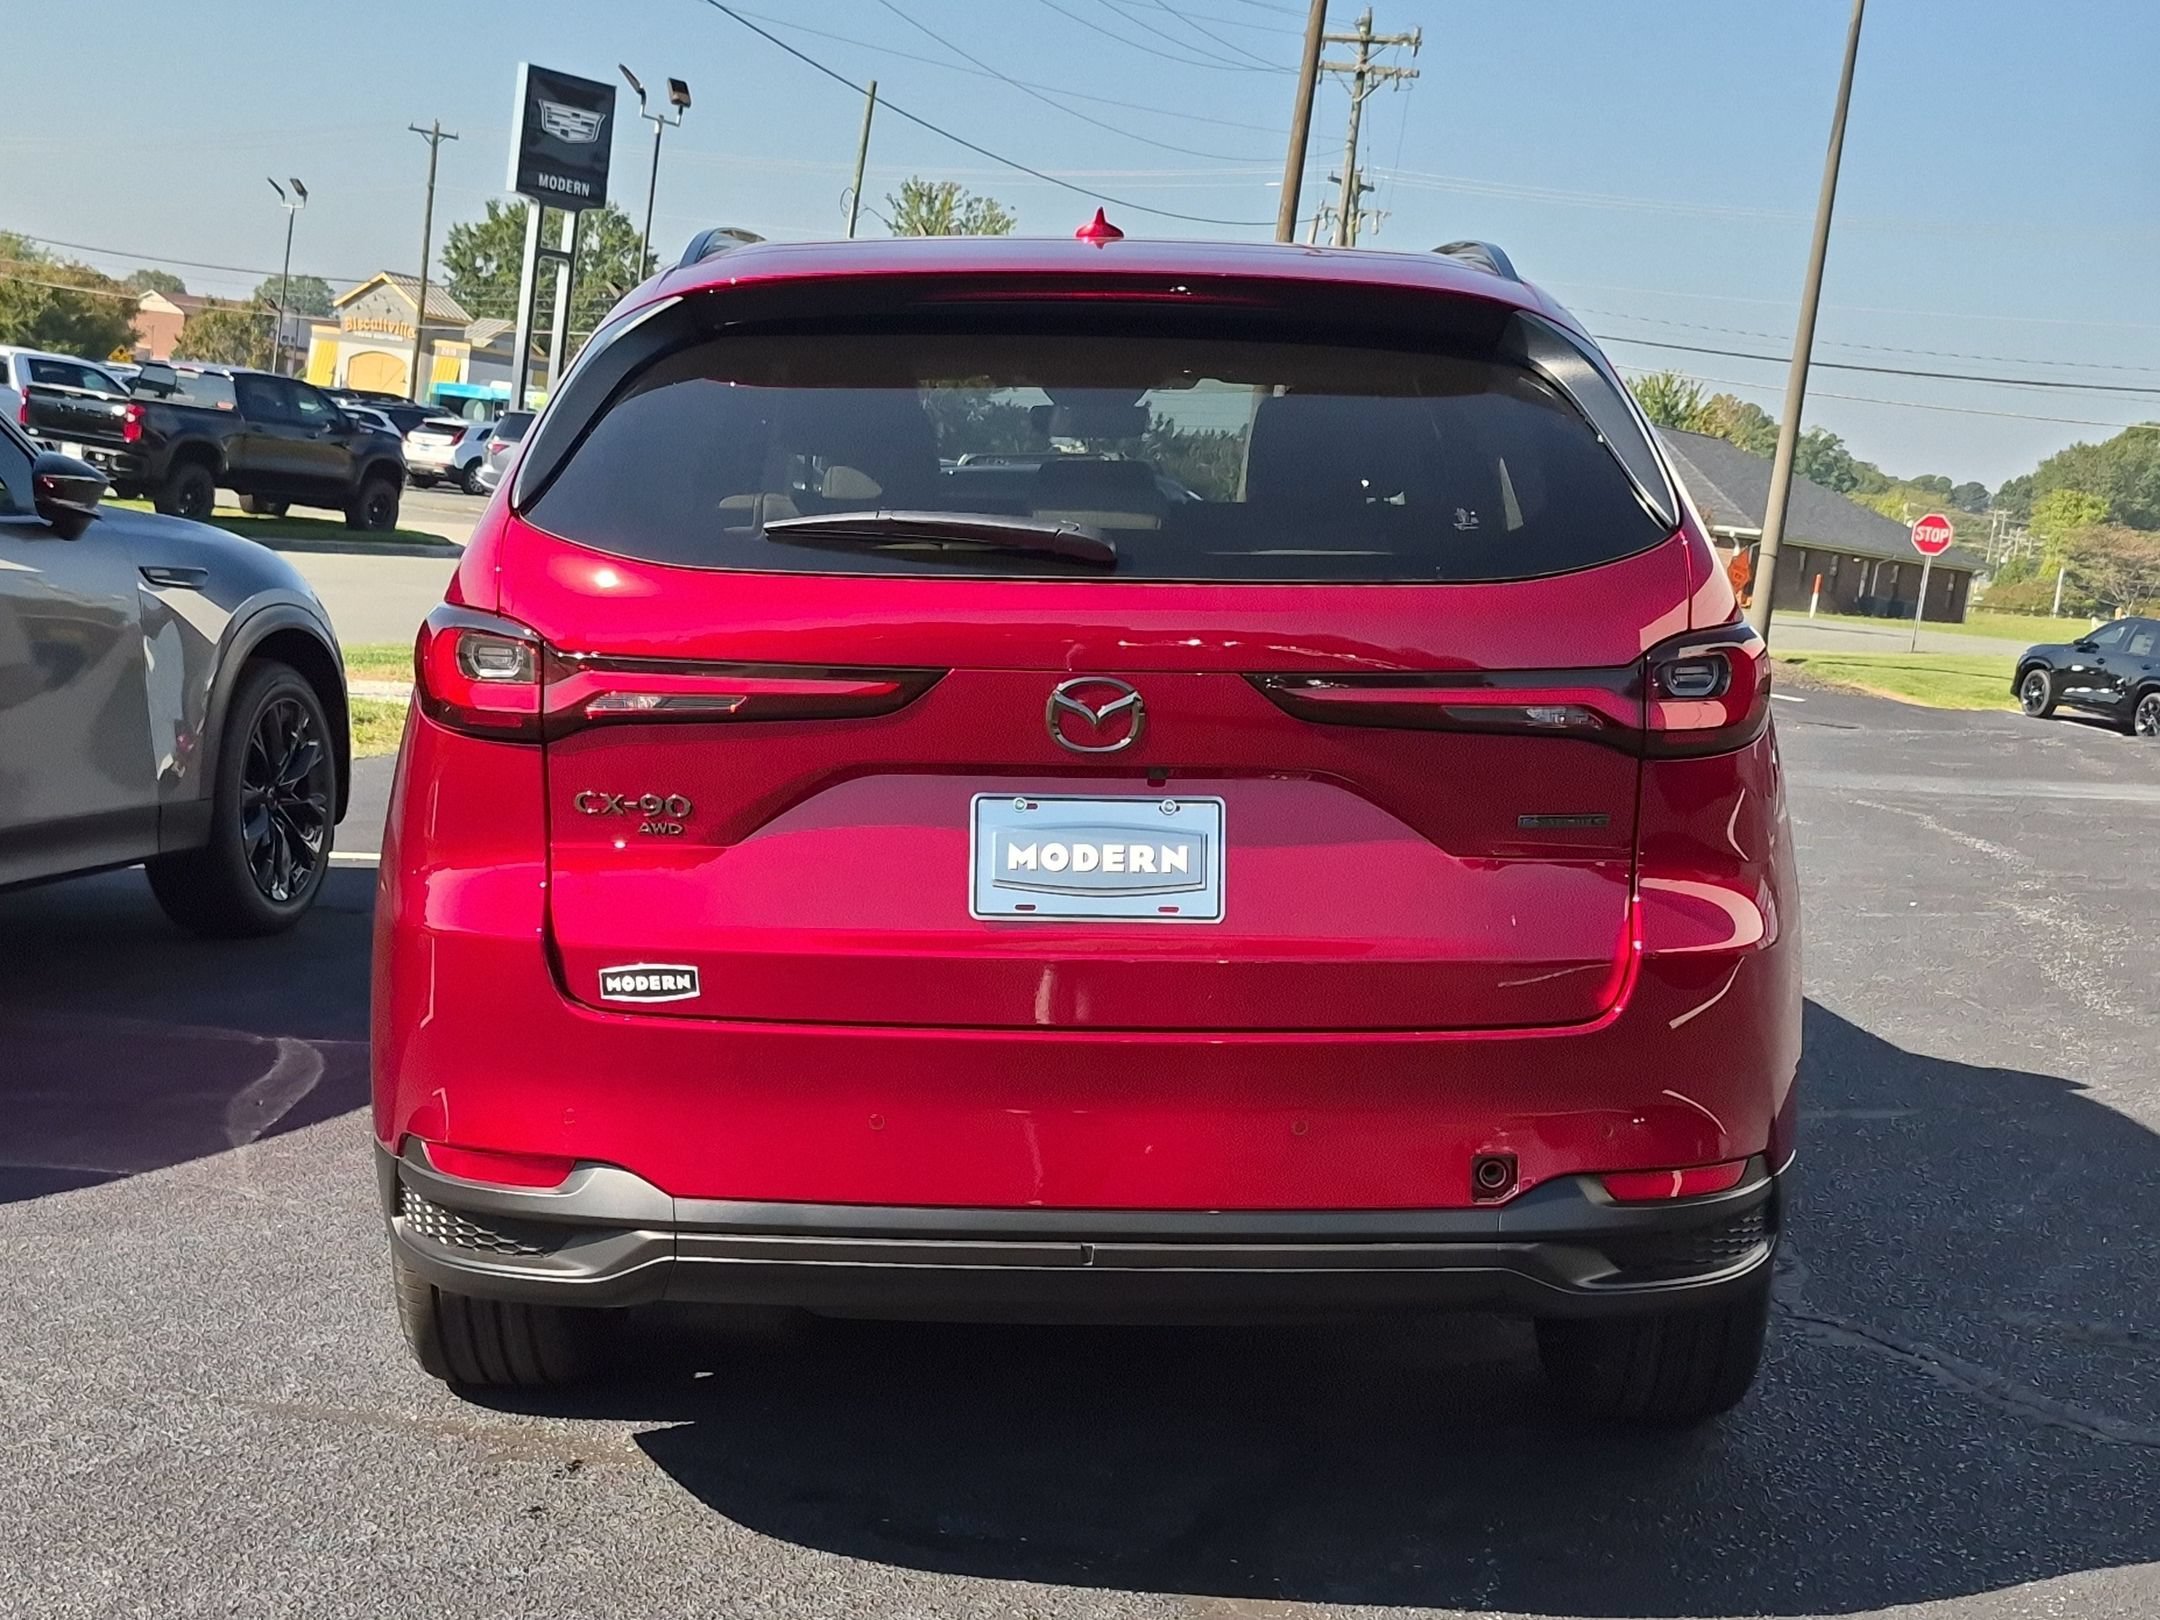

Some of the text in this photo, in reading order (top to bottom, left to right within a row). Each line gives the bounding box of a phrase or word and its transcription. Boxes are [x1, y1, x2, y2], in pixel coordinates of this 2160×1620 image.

[538, 173, 590, 197] MODERN
[1915, 525, 1949, 544] STOP
[574, 790, 693, 818] CX-90
[638, 821, 683, 835] AWD
[1007, 842, 1189, 875] MODERN
[606, 974, 692, 992] MODERN
